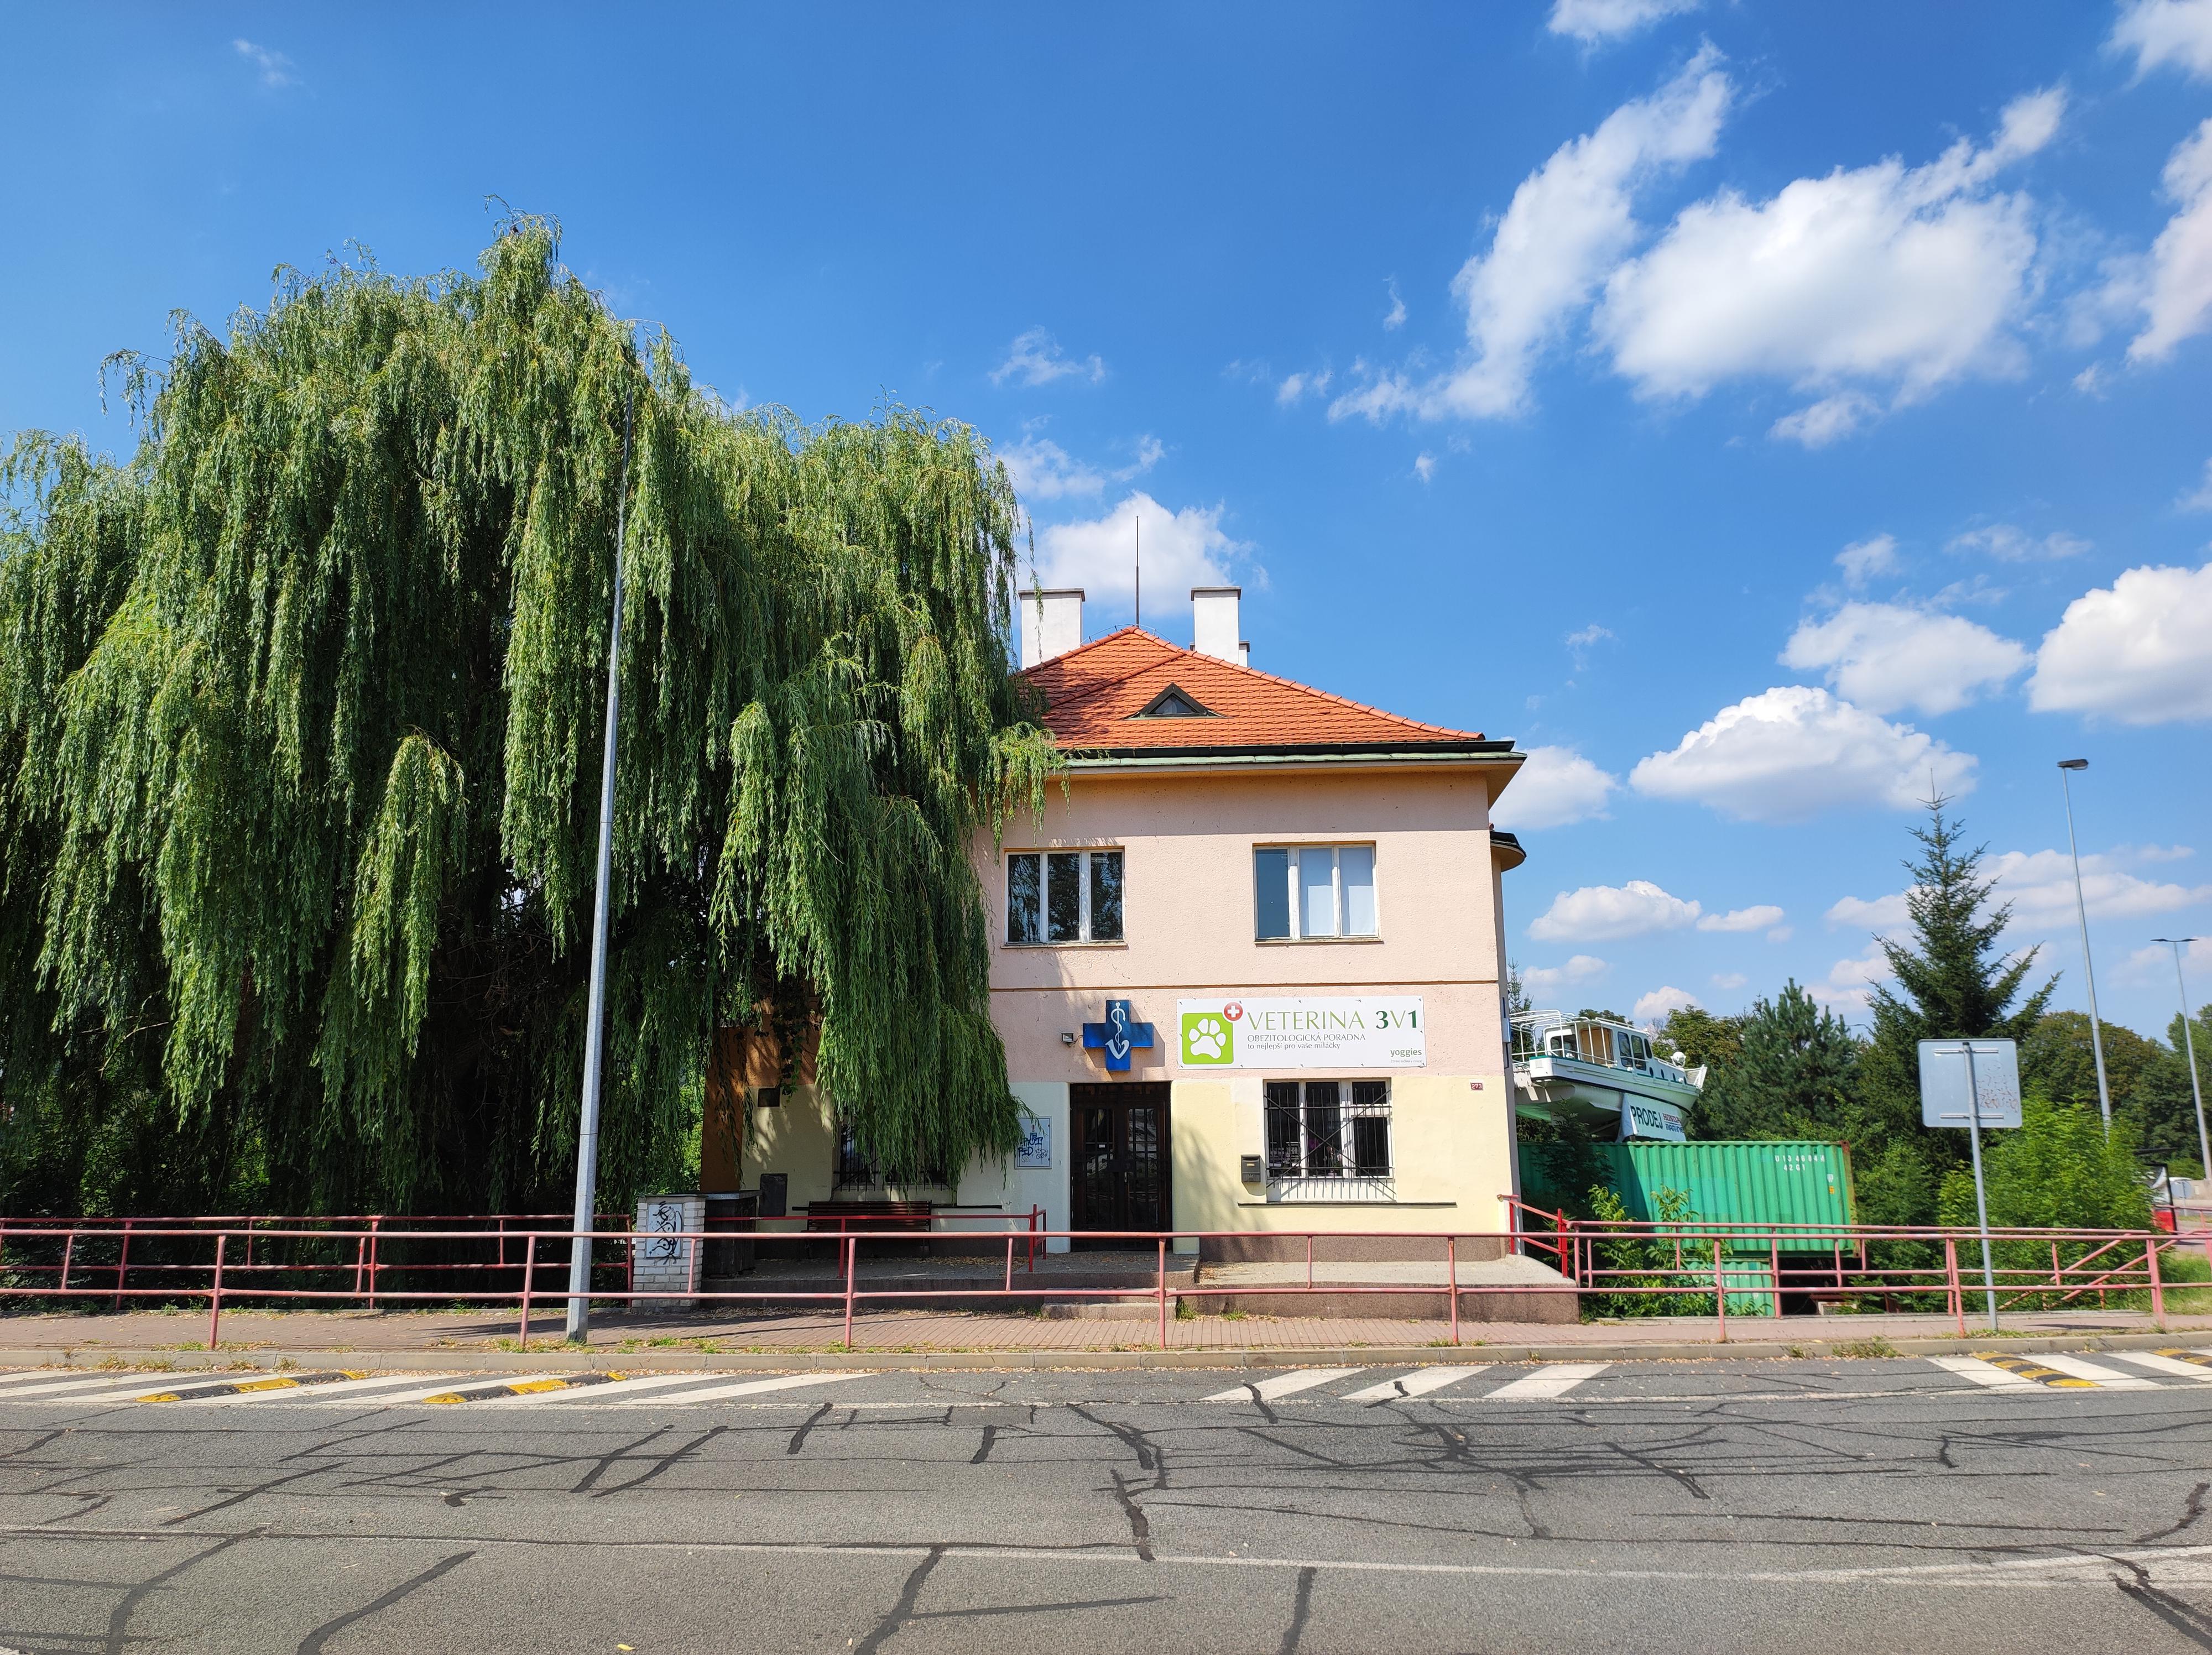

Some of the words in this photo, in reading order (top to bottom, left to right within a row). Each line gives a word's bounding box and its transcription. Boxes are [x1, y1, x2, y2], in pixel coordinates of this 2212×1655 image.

[1247, 1010, 1365, 1030] VETERINA
[1375, 1010, 1417, 1029] 3V1
[1247, 1032, 1322, 1042] OBEZITOLOGICKÁ
[1323, 1033, 1366, 1041] PORADNA
[1256, 1042, 1282, 1051] nejlepší
[1314, 1041, 1340, 1050] miláčky
[1390, 1048, 1422, 1057] yoggies
[1630, 1105, 1663, 1129] PRODEJ
